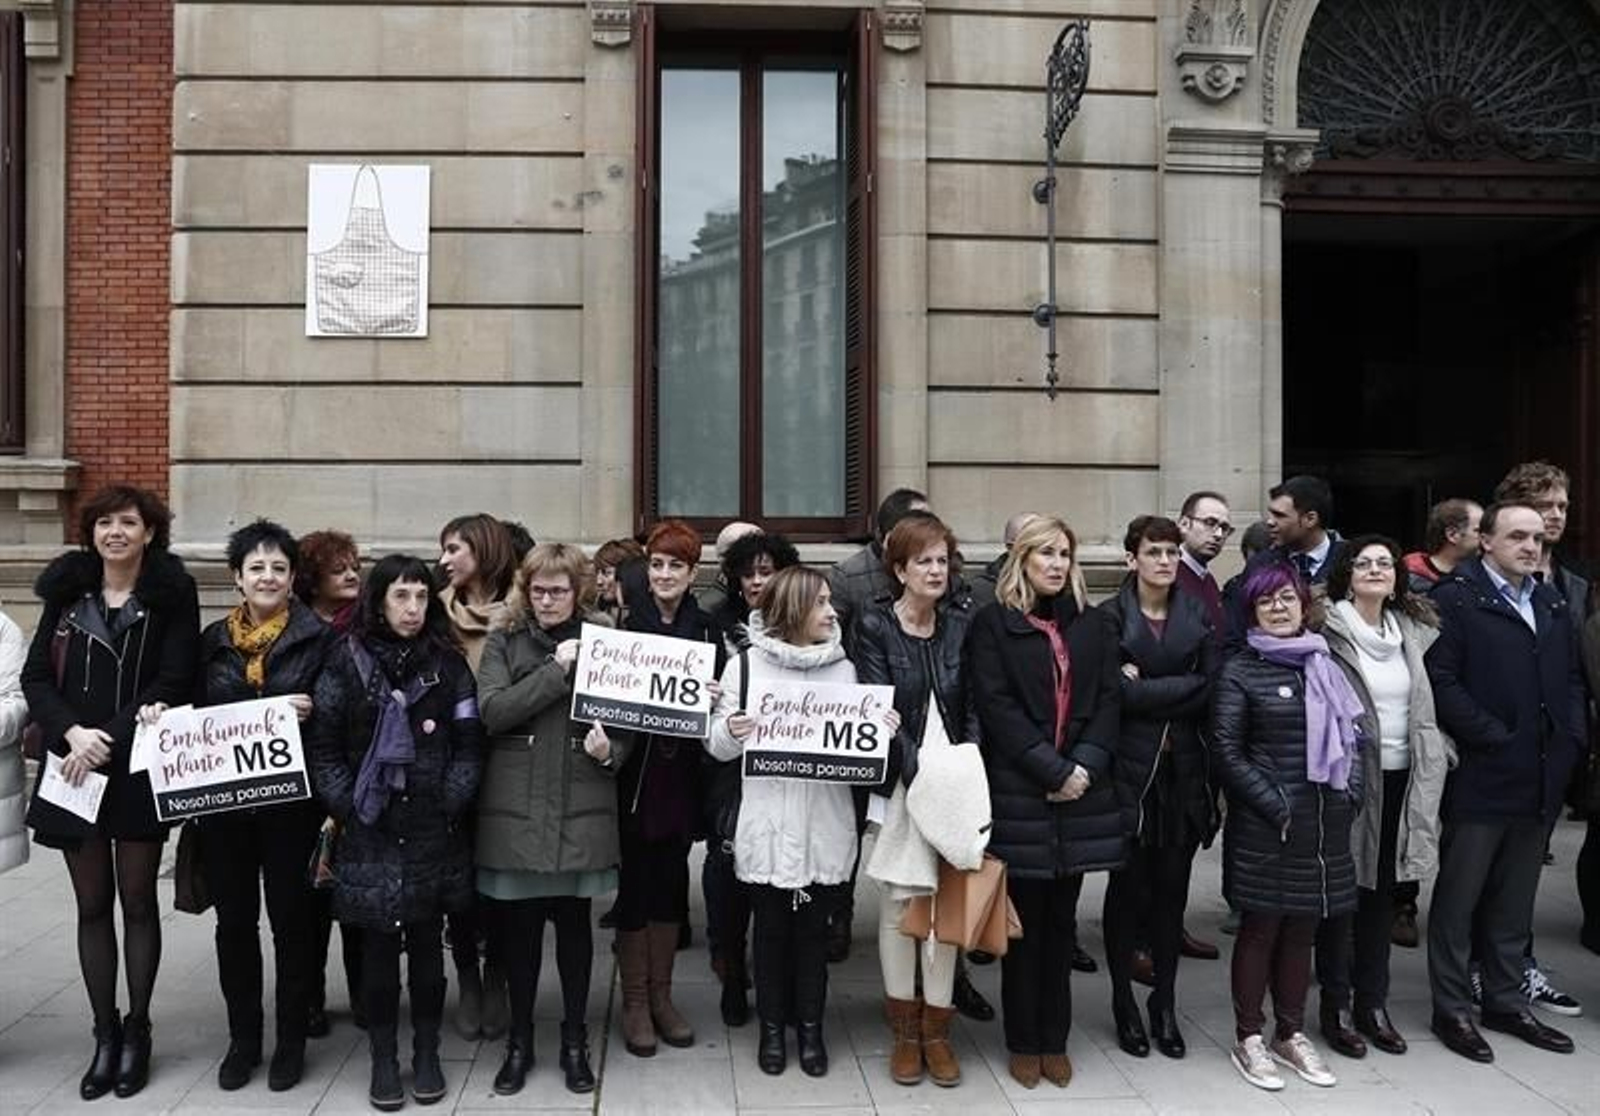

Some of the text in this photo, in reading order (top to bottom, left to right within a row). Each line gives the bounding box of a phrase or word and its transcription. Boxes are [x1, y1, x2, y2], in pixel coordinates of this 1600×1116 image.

[587, 664, 701, 706] planto M8
[582, 702, 699, 732] Nosotras paramos
[756, 717, 878, 752] planto M8
[162, 738, 293, 786] planto M8
[753, 758, 876, 778] Nosotras paramos
[168, 781, 299, 812] Nosotras paramos
